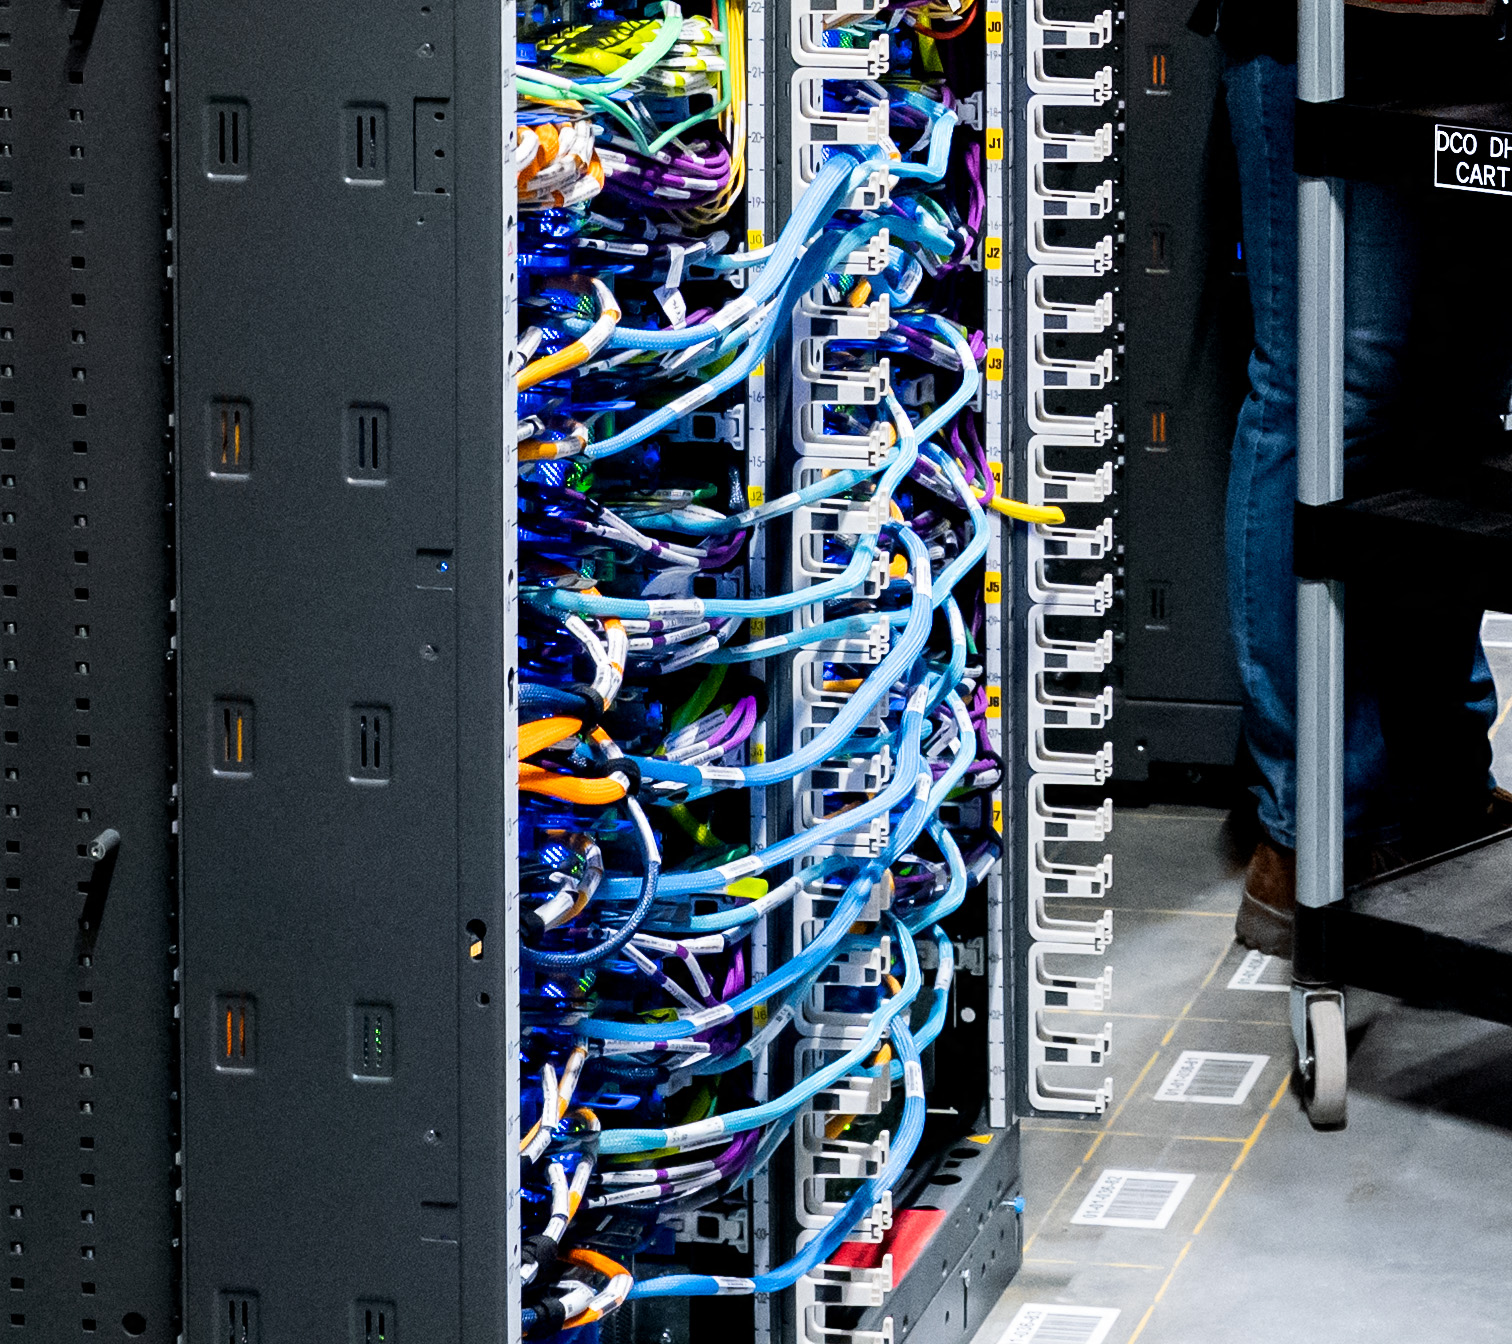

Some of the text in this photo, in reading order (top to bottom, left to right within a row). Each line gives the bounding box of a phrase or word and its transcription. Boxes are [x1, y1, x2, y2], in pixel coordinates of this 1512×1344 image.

[751, 2, 762, 14] 22
[988, 21, 1001, 33] J0
[752, 66, 762, 79] 21
[751, 132, 762, 144] 20
[988, 137, 1001, 149] J1
[1436, 130, 1478, 156] DCO
[1456, 161, 1511, 188] CART
[752, 196, 761, 208] 19
[987, 247, 1000, 259] J2
[988, 358, 1002, 370] J3
[752, 390, 762, 403] 16
[752, 456, 762, 468] 15
[750, 491, 762, 502] J2
[986, 581, 1000, 593] J5
[754, 1010, 767, 1020] J6
